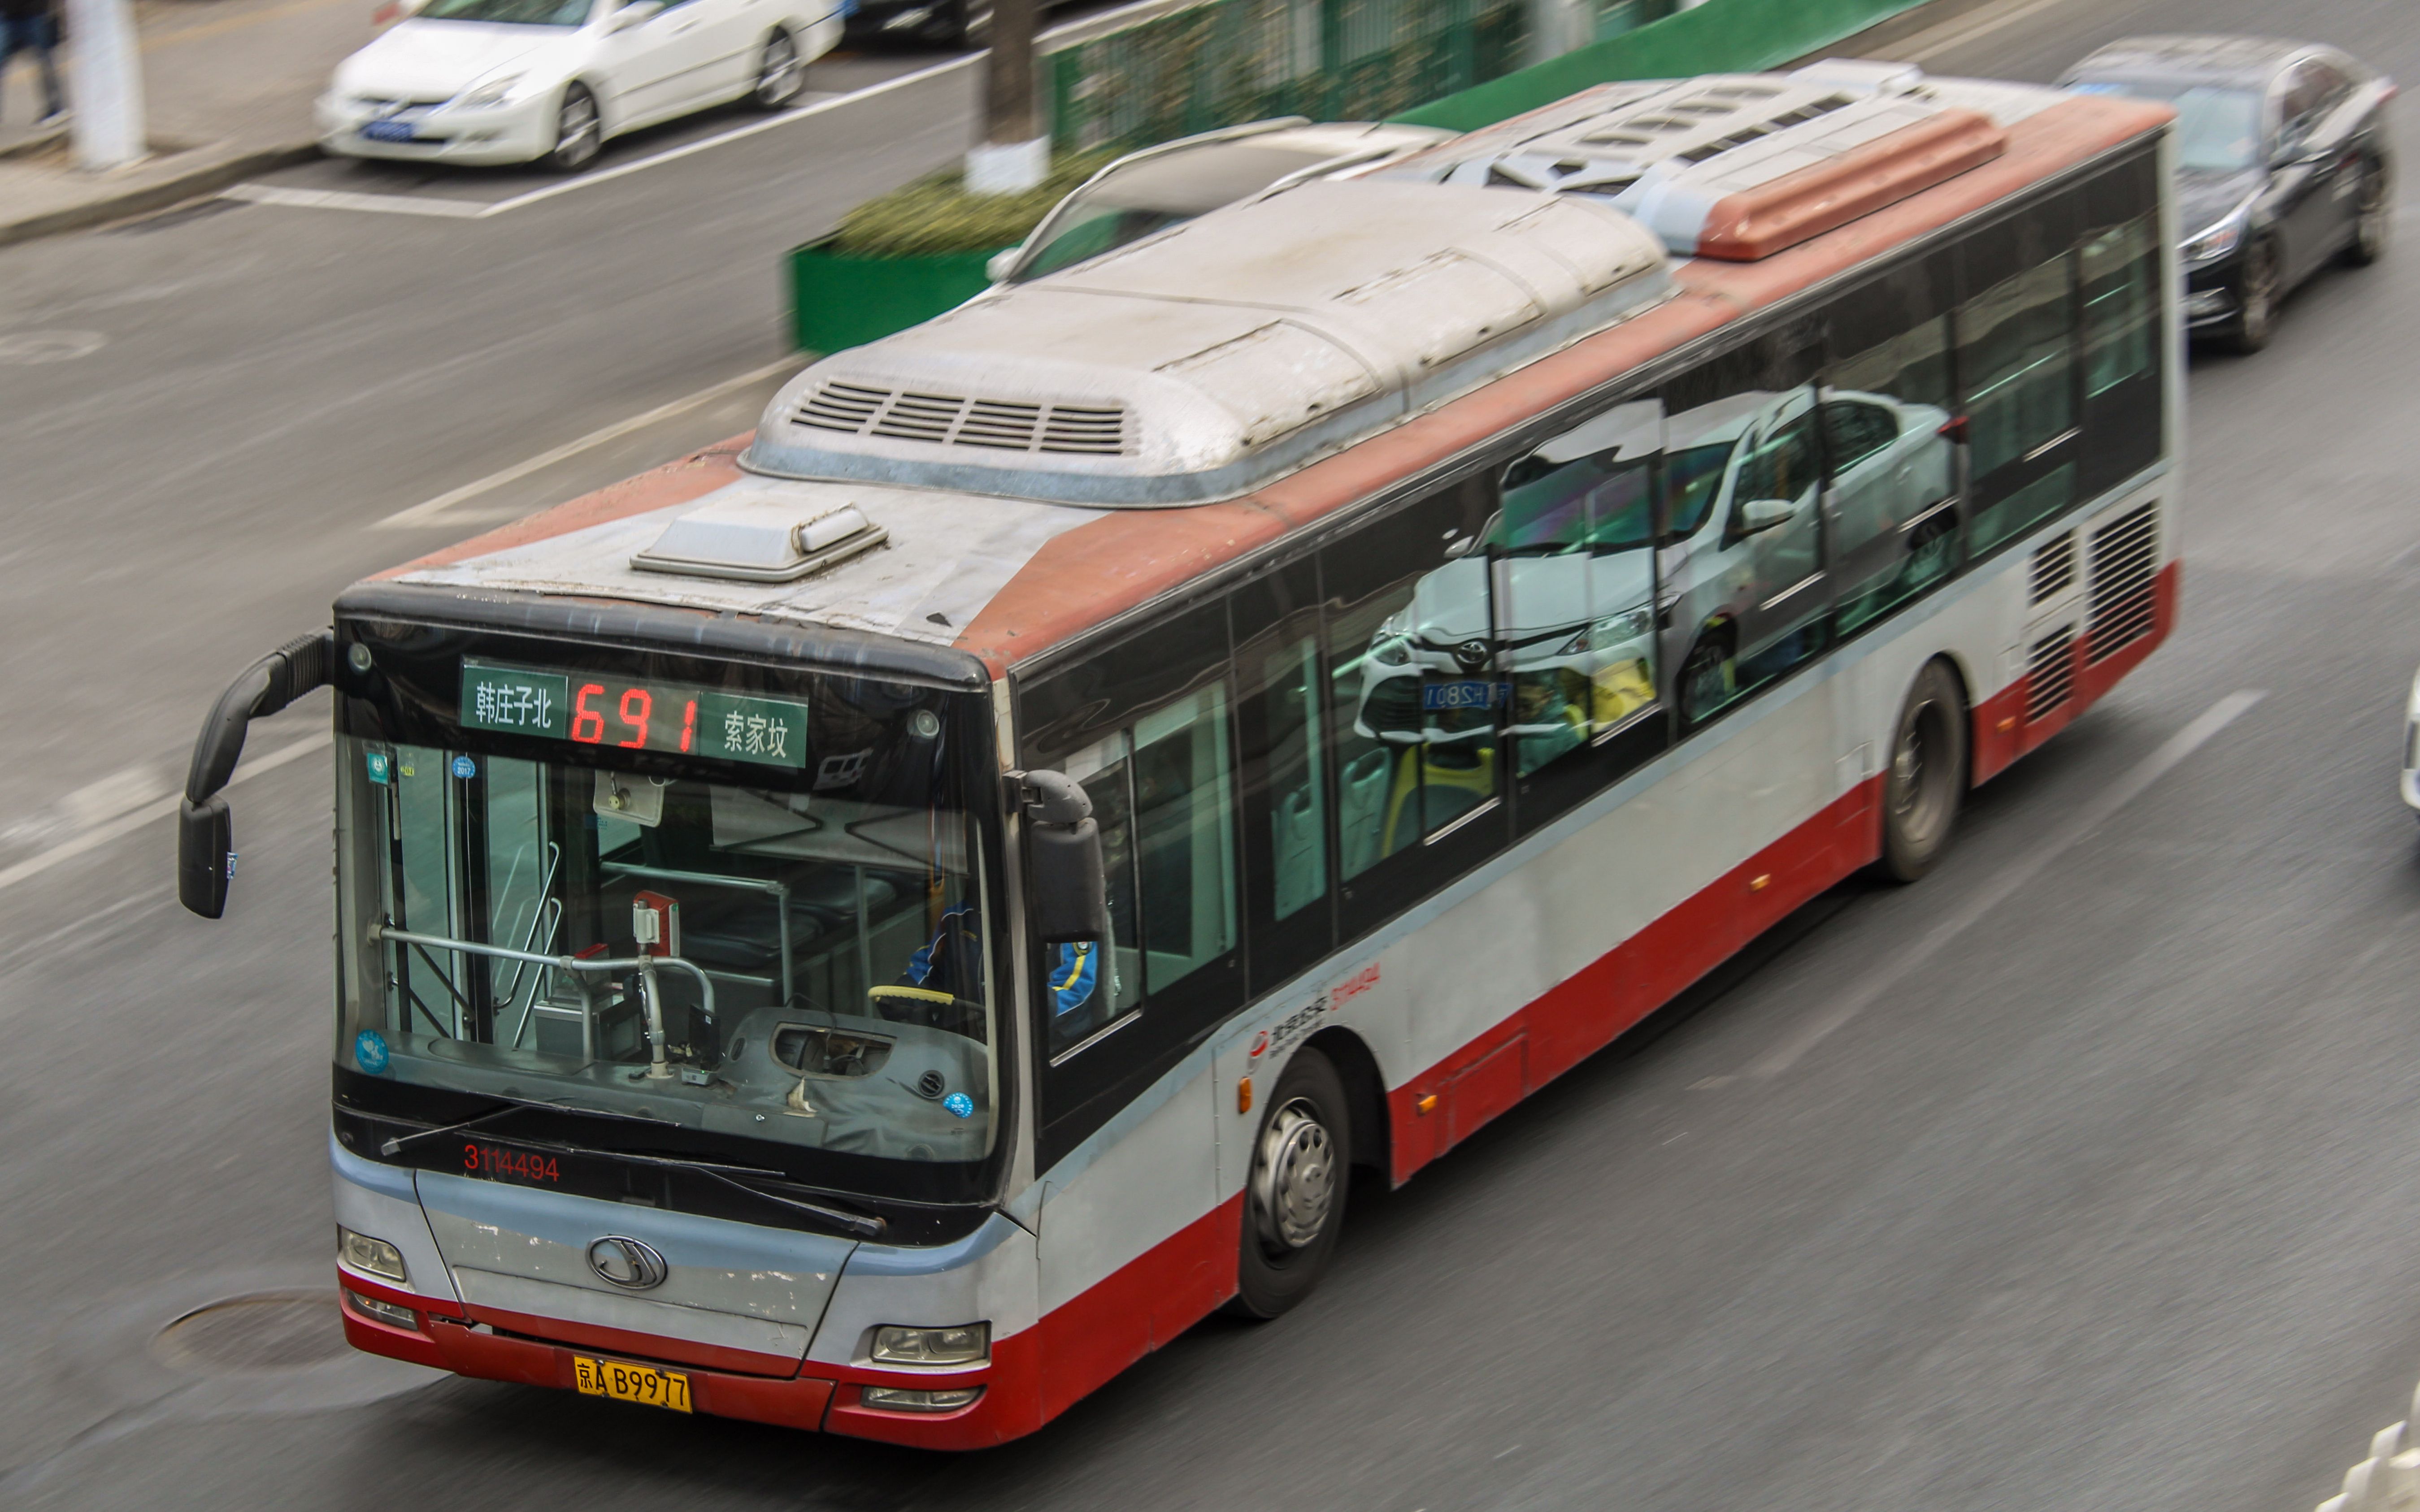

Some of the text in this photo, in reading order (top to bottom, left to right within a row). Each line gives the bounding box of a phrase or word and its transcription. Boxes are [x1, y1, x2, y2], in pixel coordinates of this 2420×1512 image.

[475, 681, 552, 729] 韩庄子北
[571, 684, 696, 753] 691
[724, 710, 788, 759] 索家坟
[457, 767, 471, 775] 2017
[464, 1144, 560, 1182] 3114494
